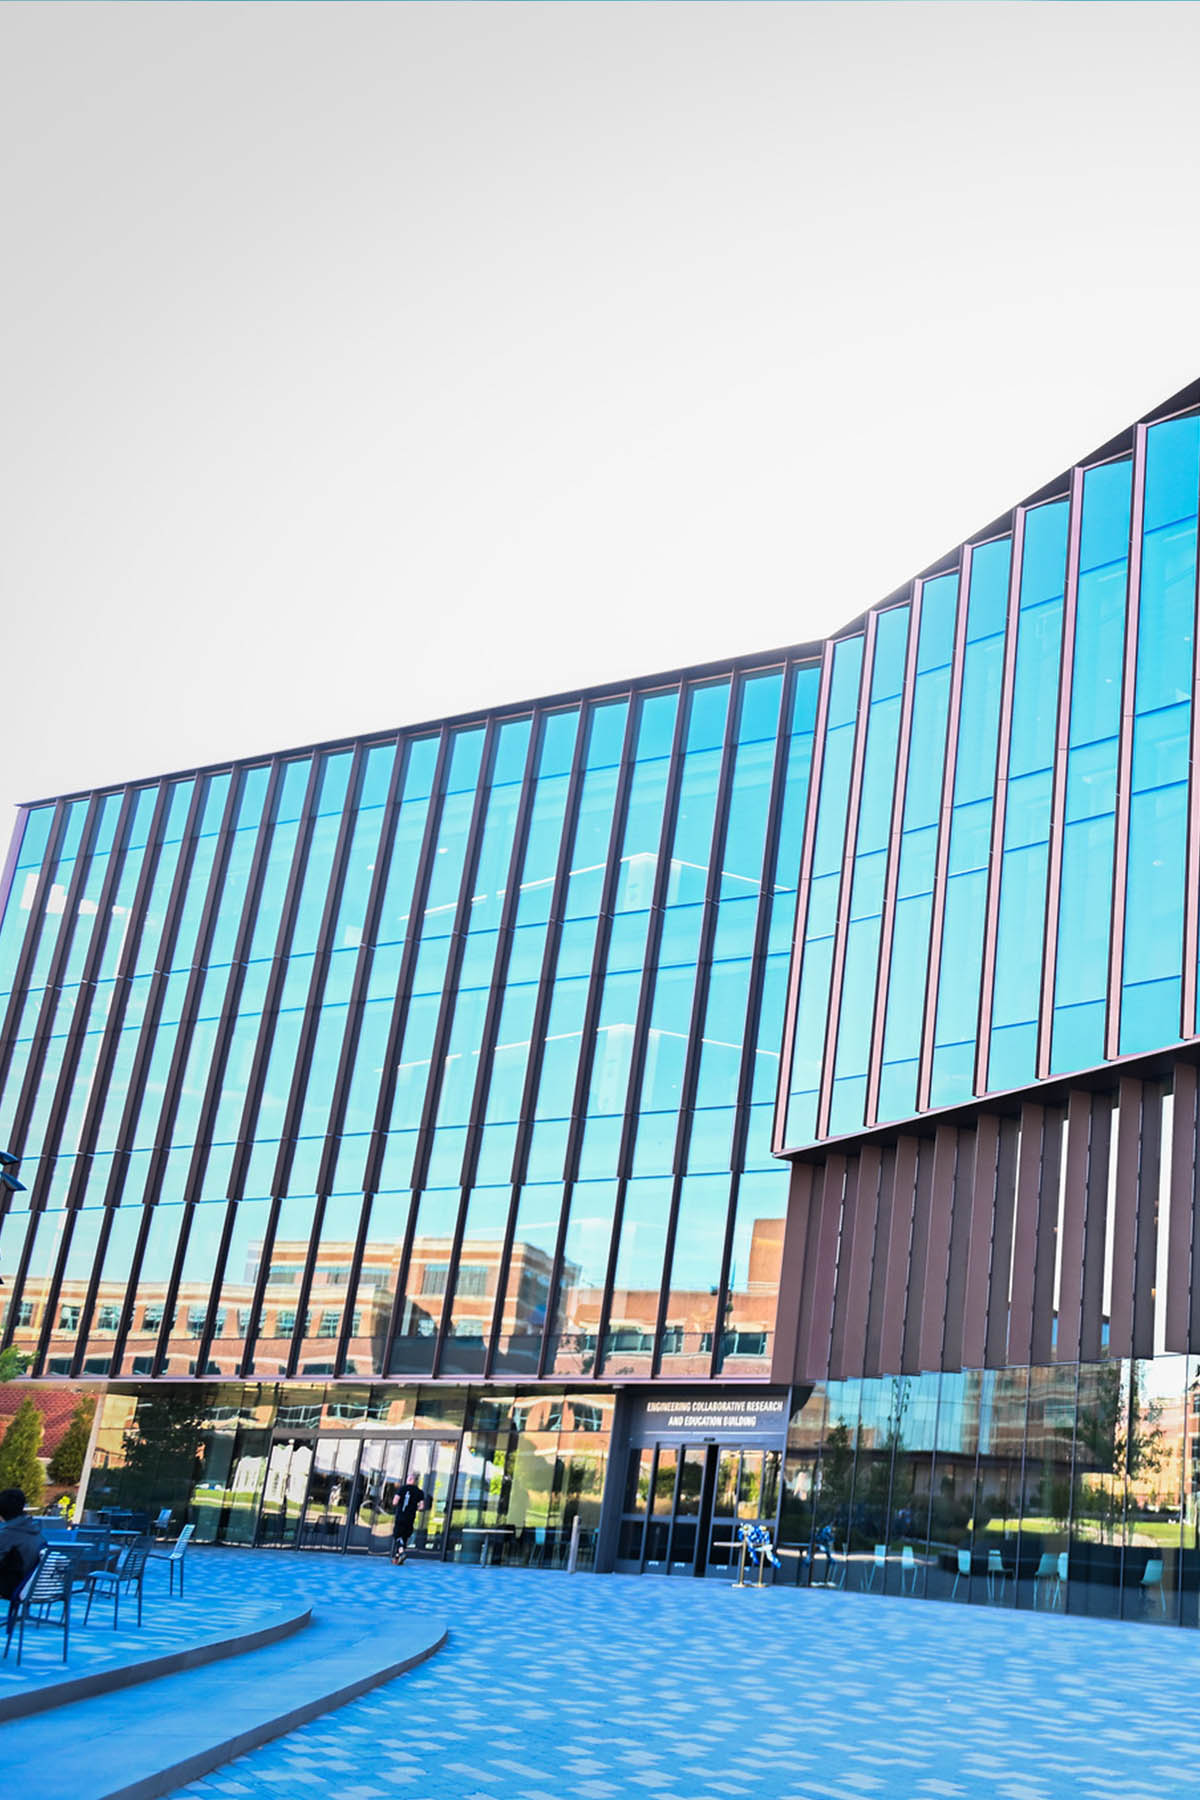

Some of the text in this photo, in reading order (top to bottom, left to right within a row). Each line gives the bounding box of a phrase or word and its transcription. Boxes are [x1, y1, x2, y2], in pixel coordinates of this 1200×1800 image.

[647, 1400, 783, 1412] ENGINEERING COLLABORATIVE RESEARCH
[668, 1415, 757, 1427] AND EDUCATION BUILDING
